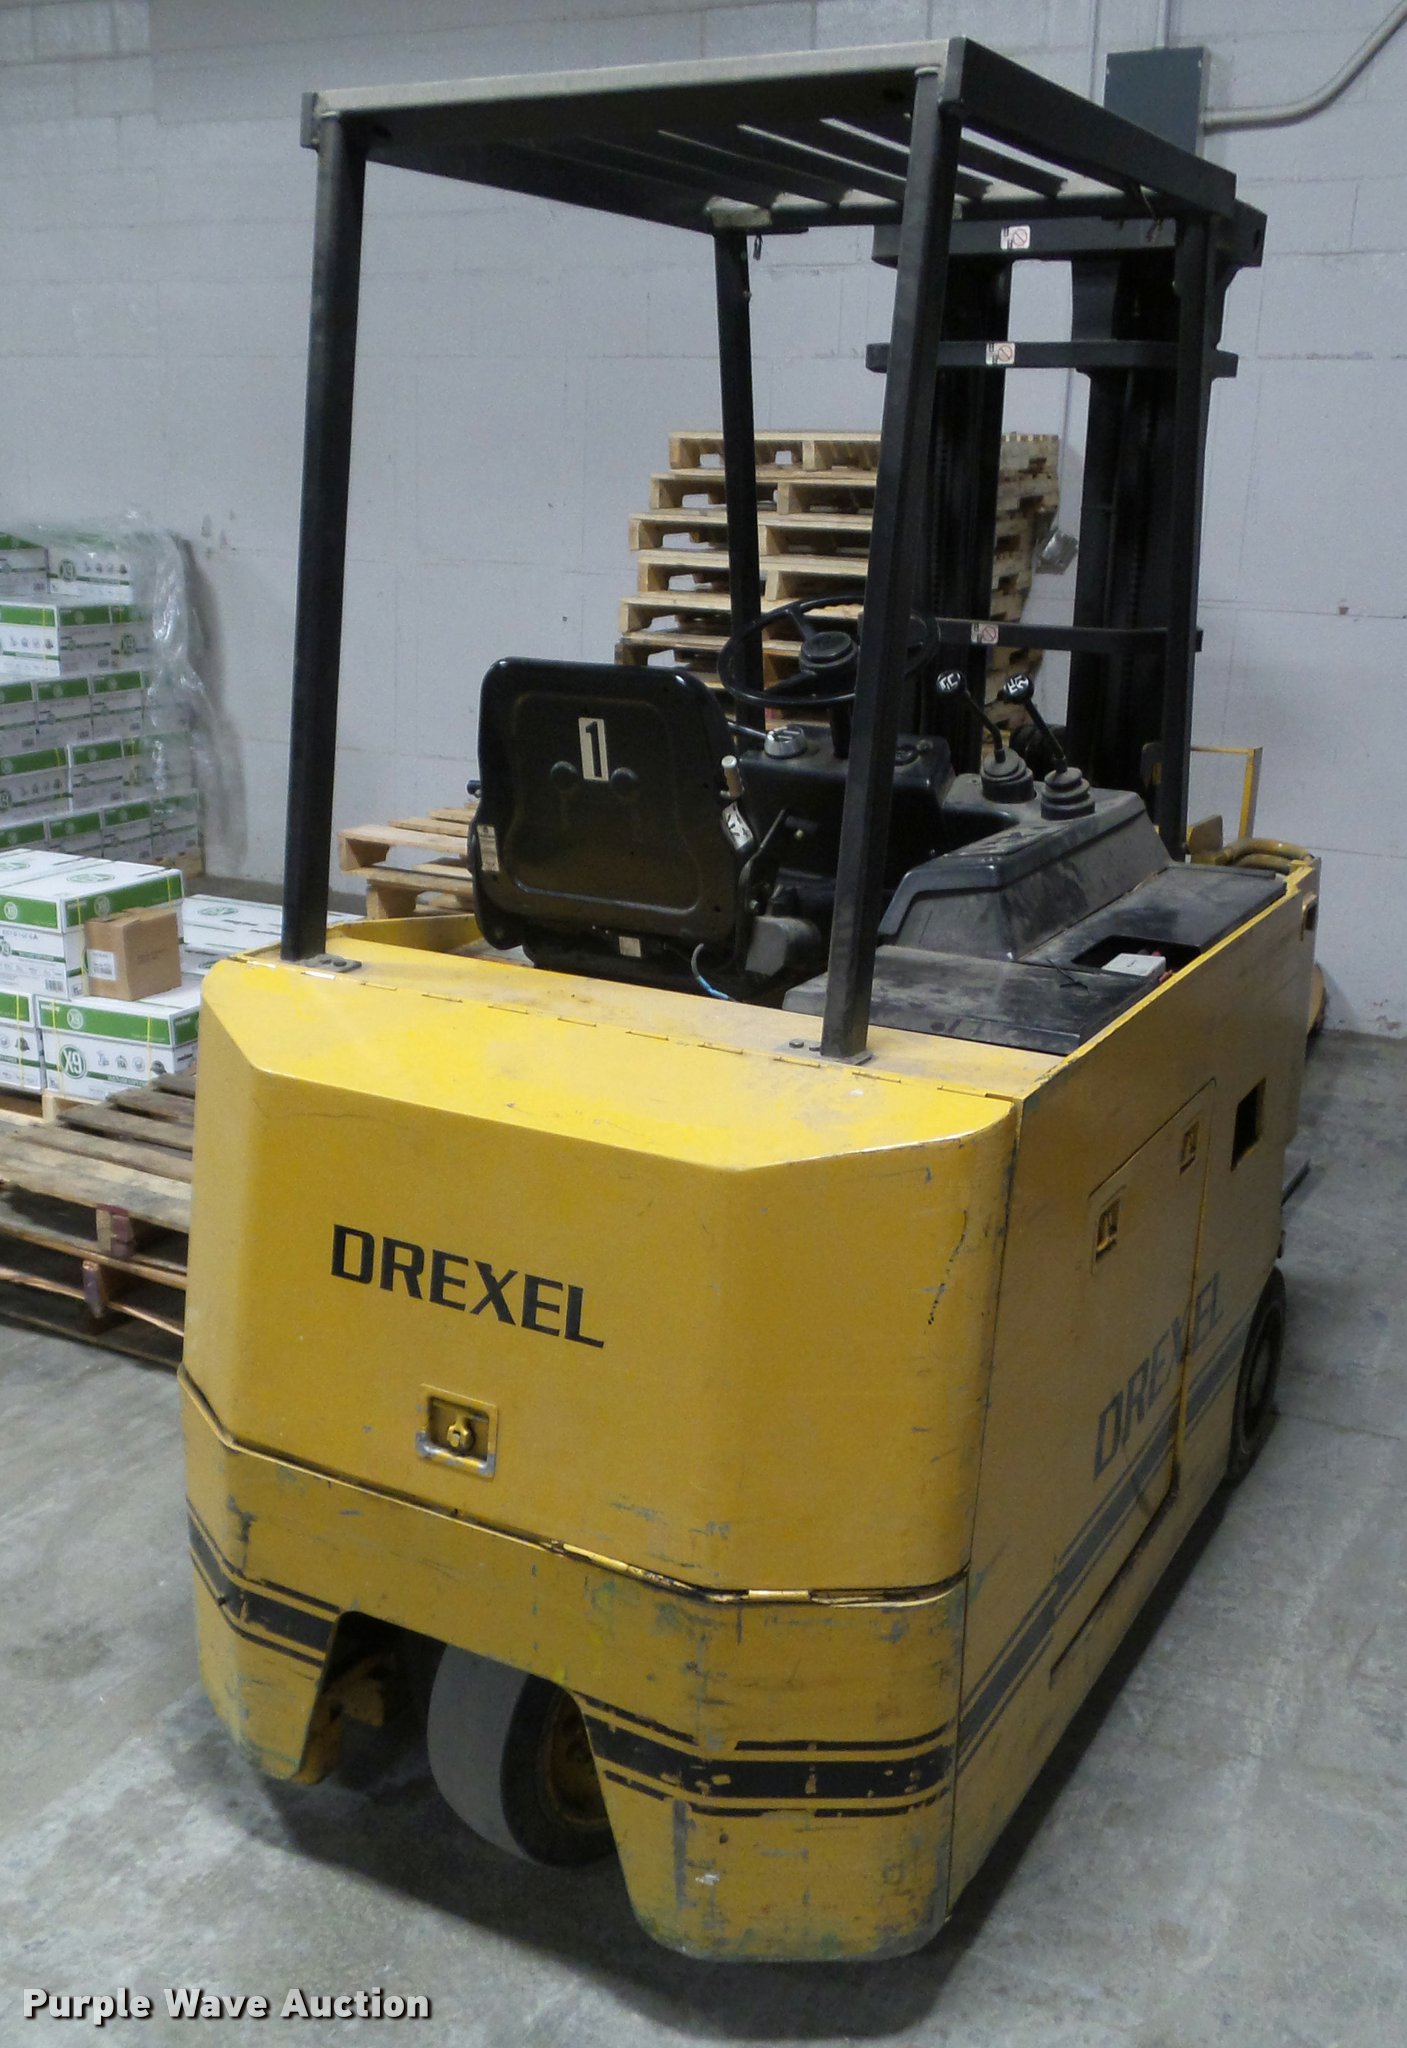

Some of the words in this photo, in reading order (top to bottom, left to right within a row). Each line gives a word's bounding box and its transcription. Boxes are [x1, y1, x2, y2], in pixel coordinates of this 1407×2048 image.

[585, 721, 602, 778] 1
[64, 1049, 82, 1075] X9
[331, 1224, 604, 1349] DREXEL
